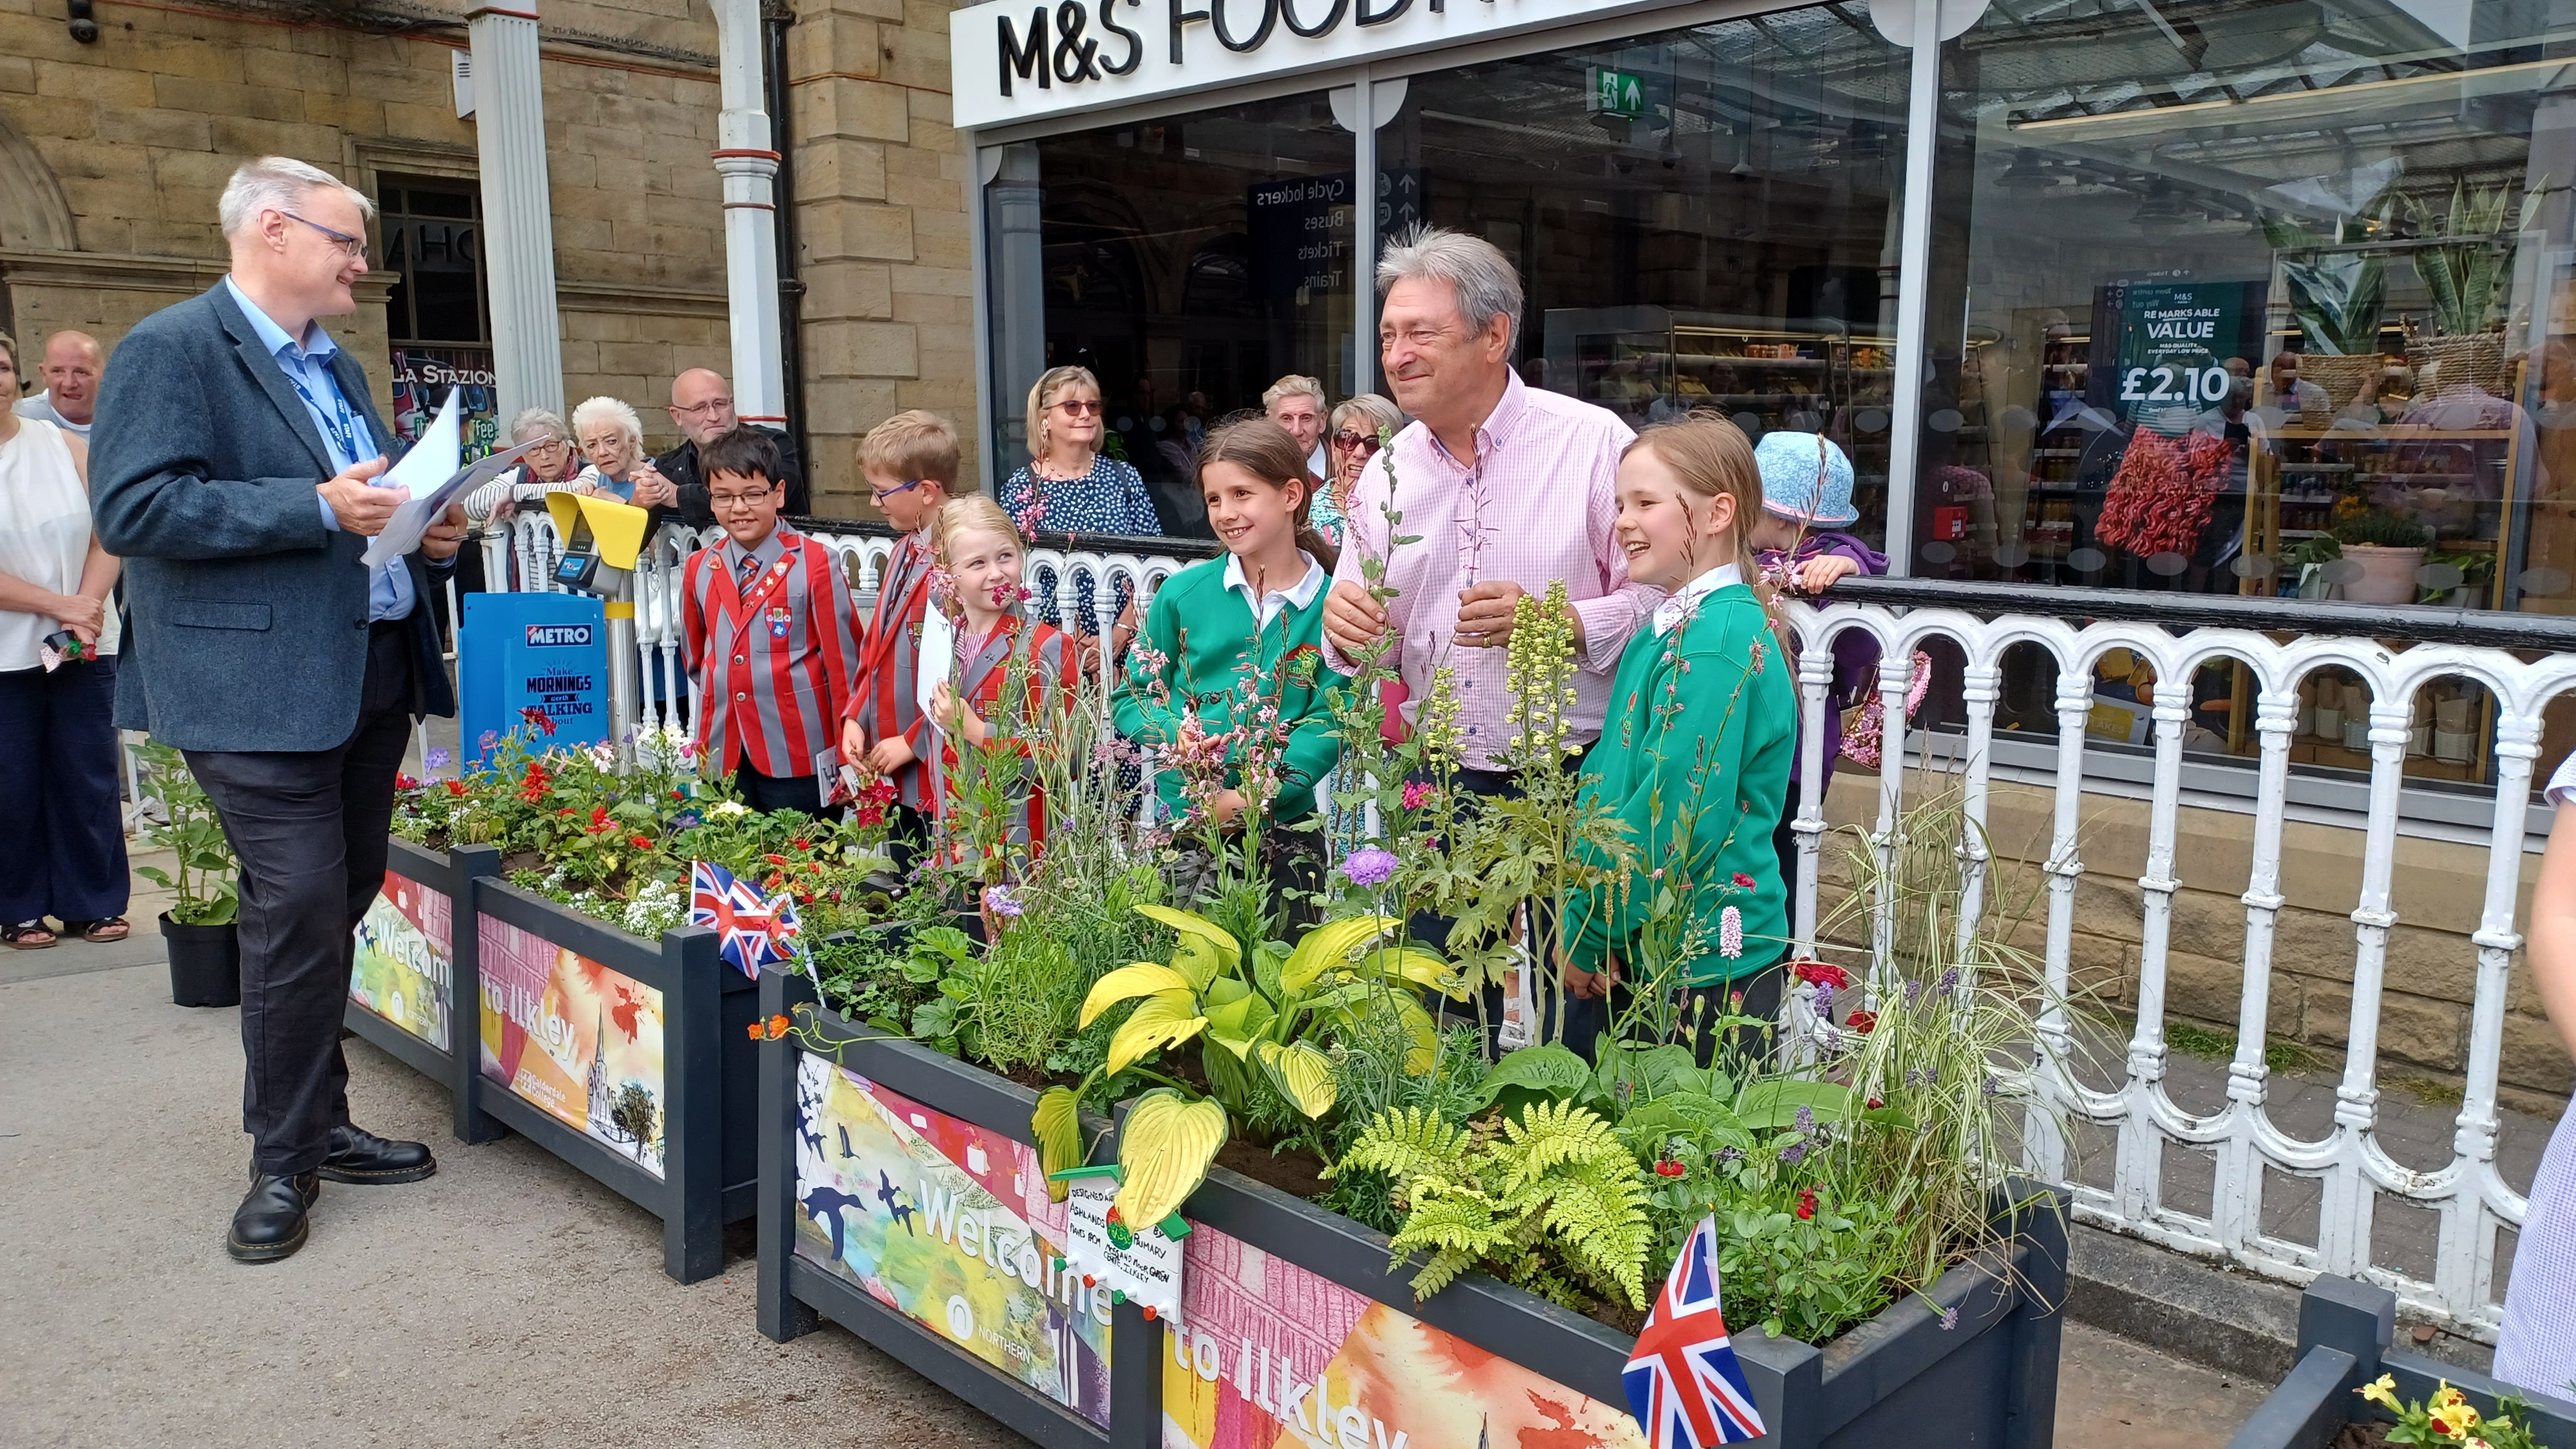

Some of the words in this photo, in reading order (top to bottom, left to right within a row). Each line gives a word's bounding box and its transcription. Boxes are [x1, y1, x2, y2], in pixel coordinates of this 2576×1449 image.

[997, 0, 1142, 97] M&S
[2174, 292, 2193, 301] M&S
[2144, 310, 2157, 319] RE
[2158, 309, 2193, 319] MARKS
[2194, 308, 2221, 317] ABLE
[2147, 322, 2215, 339] VALUE
[2120, 366, 2230, 402] £2.10
[337, 398, 345, 414] STAFF
[343, 423, 352, 439] STAFF
[530, 627, 589, 645] METRO
[547, 667, 573, 676] Make
[526, 675, 592, 694] MORNINGS
[483, 972, 504, 1016] to
[511, 982, 574, 1061] Ilkley
[531, 1085, 555, 1108] College
[532, 1074, 566, 1103] Calderdale
[1072, 1189, 1103, 1202] DESIGNED
[1069, 1201, 1105, 1229] ASHLANDS
[1133, 1233, 1166, 1259] PRIMARY
[918, 1179, 1113, 1327] Welcome
[978, 1325, 1030, 1365] NORTHERN
[1172, 1321, 1221, 1383] to
